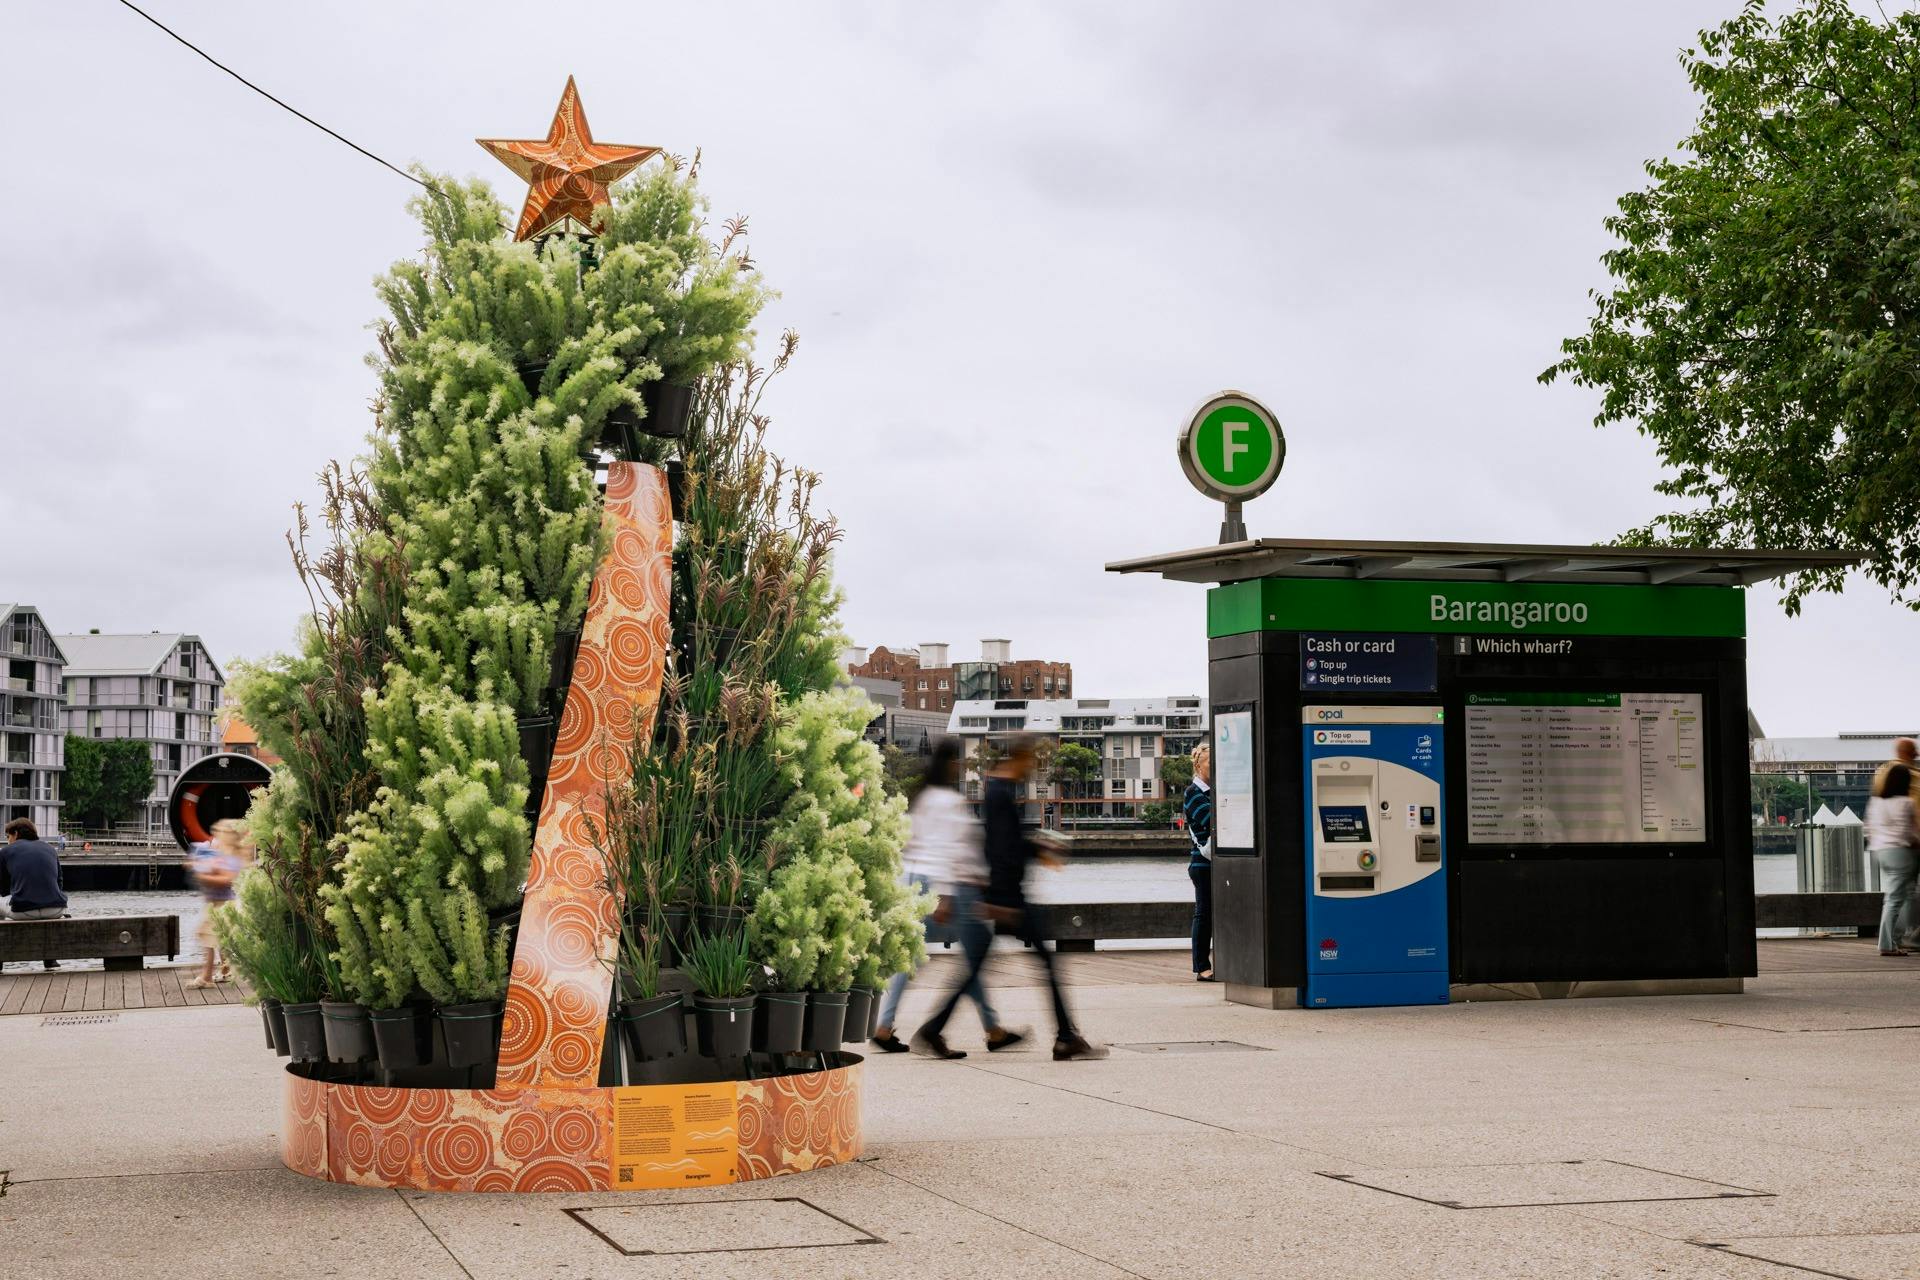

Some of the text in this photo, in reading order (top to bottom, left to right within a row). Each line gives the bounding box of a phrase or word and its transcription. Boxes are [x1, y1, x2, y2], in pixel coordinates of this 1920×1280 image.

[1222, 421, 1250, 472] F
[1430, 595, 1588, 629] Barangaroo
[1307, 637, 1395, 653] Cash or card
[1476, 638, 1520, 653] Which
[1524, 639, 1573, 654] wharf?
[1319, 660, 1347, 671] Top up
[1319, 674, 1391, 685] Single trip tickets
[1318, 709, 1343, 720] opal
[1320, 950, 1338, 958] NSW
